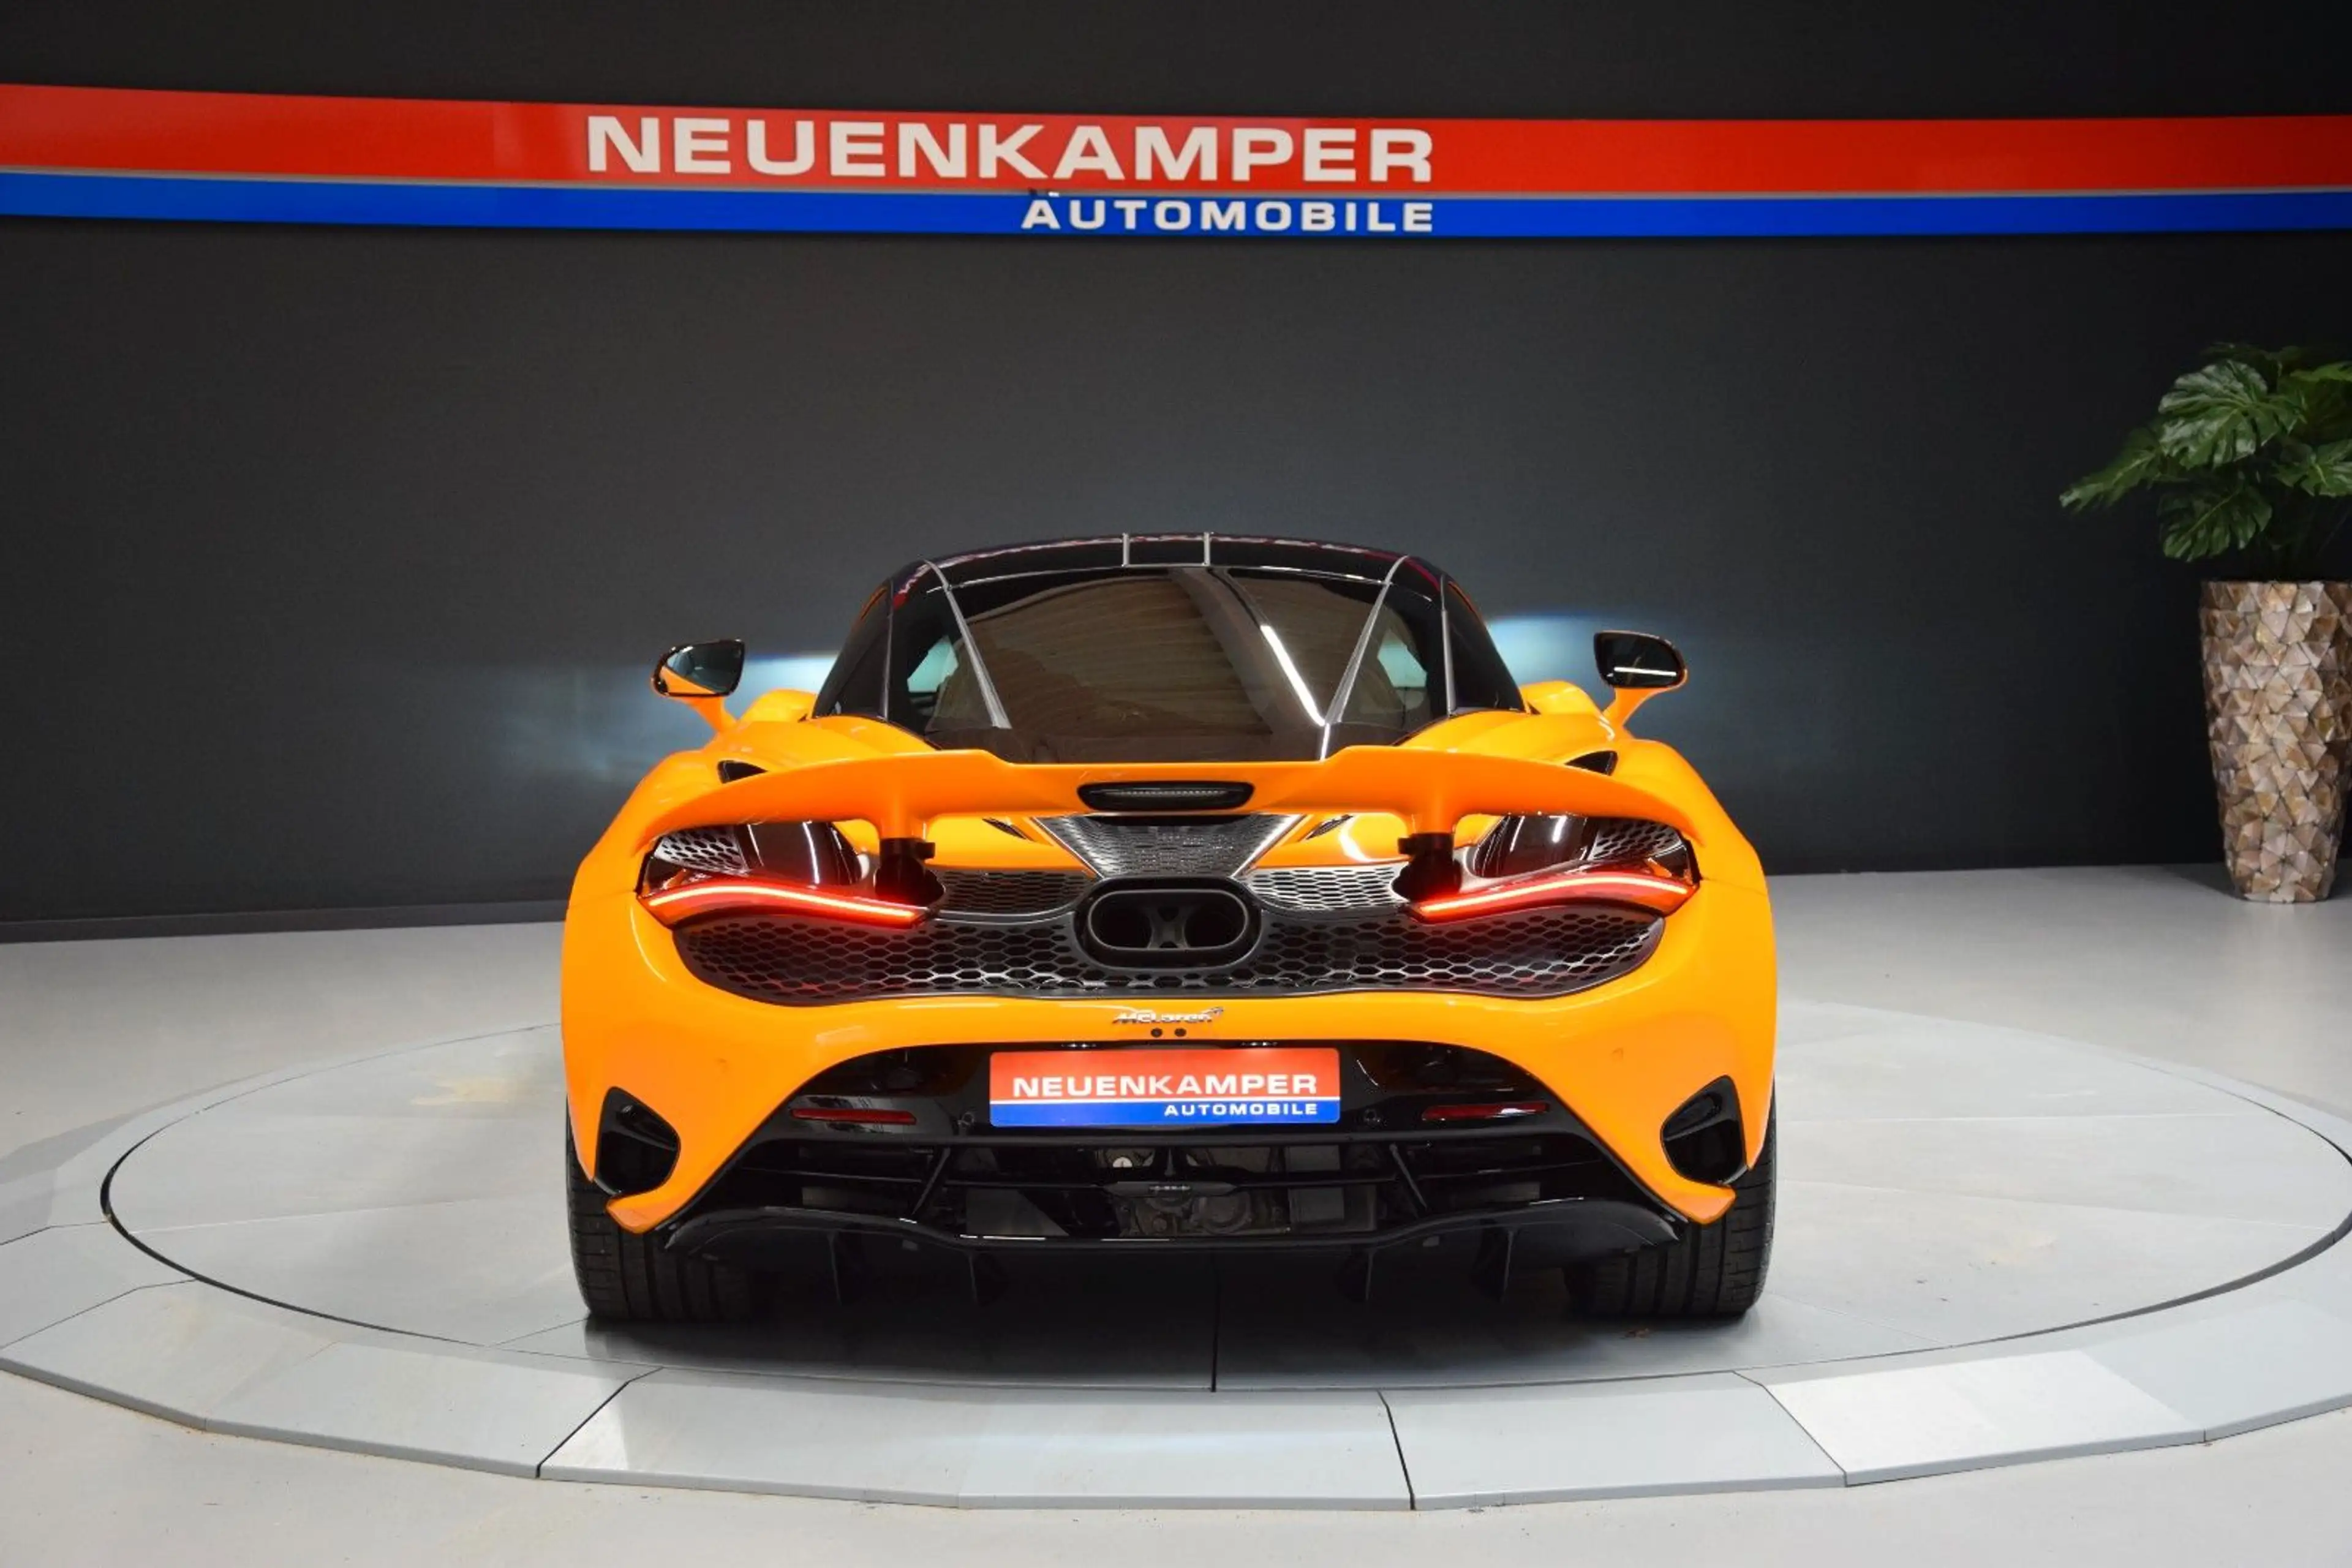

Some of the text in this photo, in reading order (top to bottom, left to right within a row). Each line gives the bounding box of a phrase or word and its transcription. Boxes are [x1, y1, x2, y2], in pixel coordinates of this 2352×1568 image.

[588, 116, 1432, 182] NEUENKAMPER
[1021, 199, 1433, 232] AUTOMOBILE
[1012, 1074, 1317, 1098] NEUENKAMPER
[1164, 1102, 1317, 1117] AUTOMOBILE
